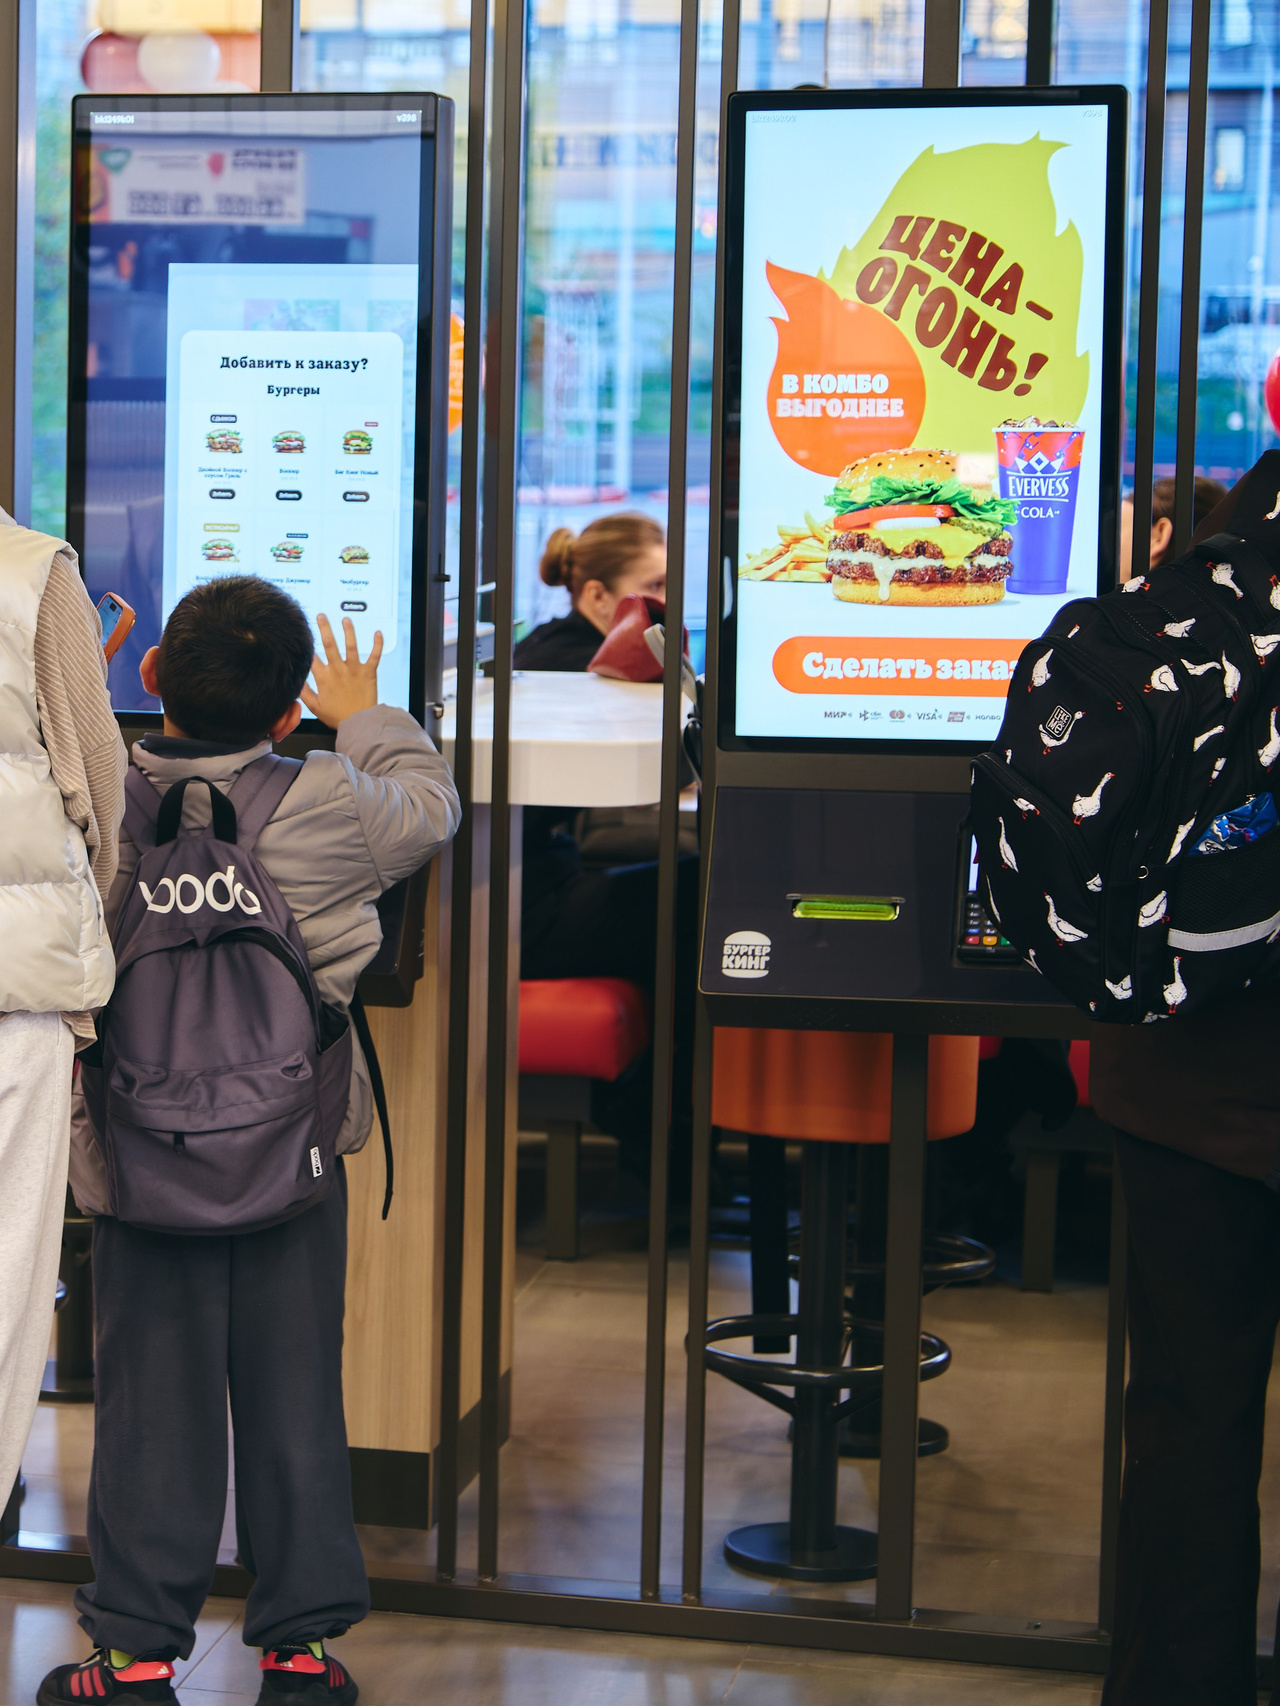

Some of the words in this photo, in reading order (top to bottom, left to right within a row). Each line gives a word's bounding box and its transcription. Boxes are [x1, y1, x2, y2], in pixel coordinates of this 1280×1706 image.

[855, 256, 1049, 397] ОГОНЬ!
[220, 356, 291, 369] Добавить
[295, 360, 305, 369] к
[308, 358, 368, 373] заказу?
[267, 385, 321, 397] Бургеры
[782, 374, 799, 394] В
[803, 373, 889, 394] КОМБО
[776, 398, 904, 419] ВЫГОДНЕЕ
[1008, 476, 1069, 497] EVERVESS
[1020, 506, 1055, 518] COLA
[802, 652, 933, 680] Сделать
[916, 711, 938, 720] VISA
[723, 944, 771, 956] БУРГЕР
[722, 955, 770, 969] КИНГ
